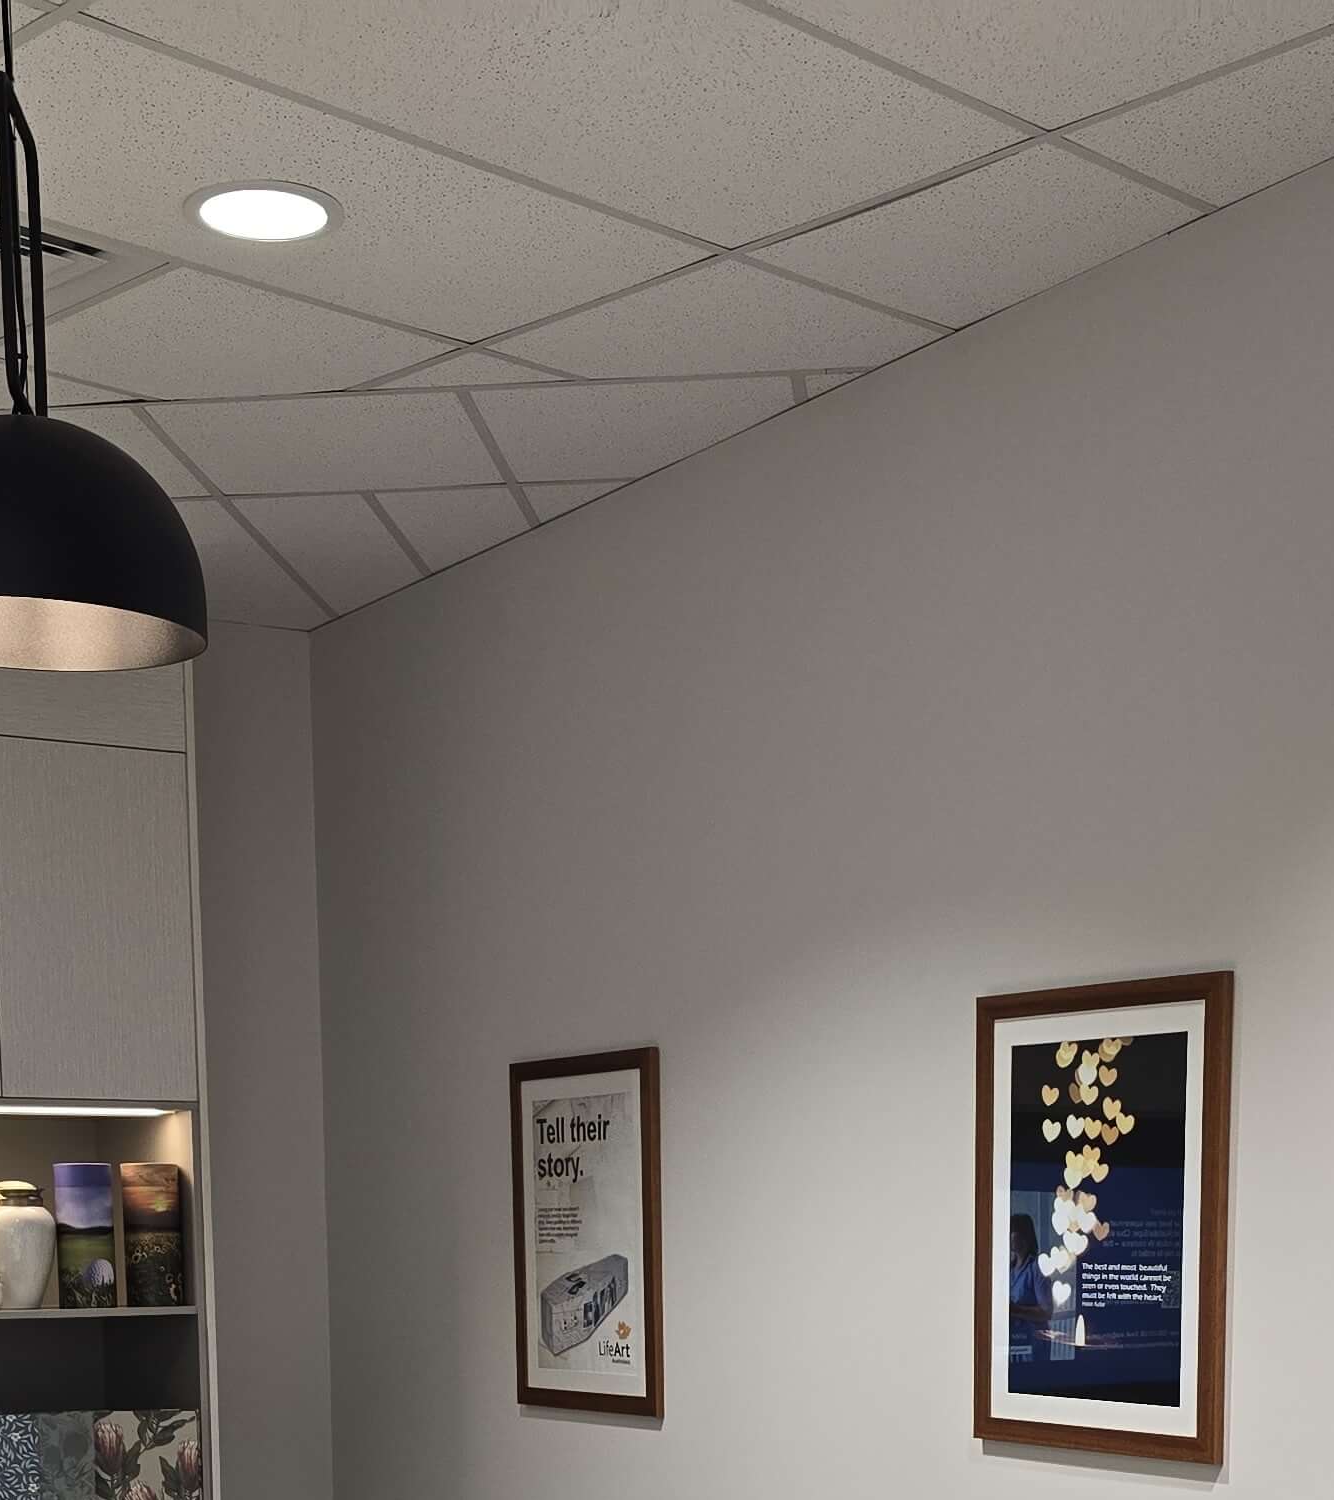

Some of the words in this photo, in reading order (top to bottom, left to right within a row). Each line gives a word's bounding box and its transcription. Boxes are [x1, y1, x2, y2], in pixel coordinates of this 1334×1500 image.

[536, 1116, 565, 1145] Tell
[570, 1114, 611, 1143] their
[537, 1152, 584, 1184] story.
[1082, 1262, 1093, 1271] The
[1150, 1283, 1167, 1293] They
[598, 1340, 631, 1358] LifeArt
